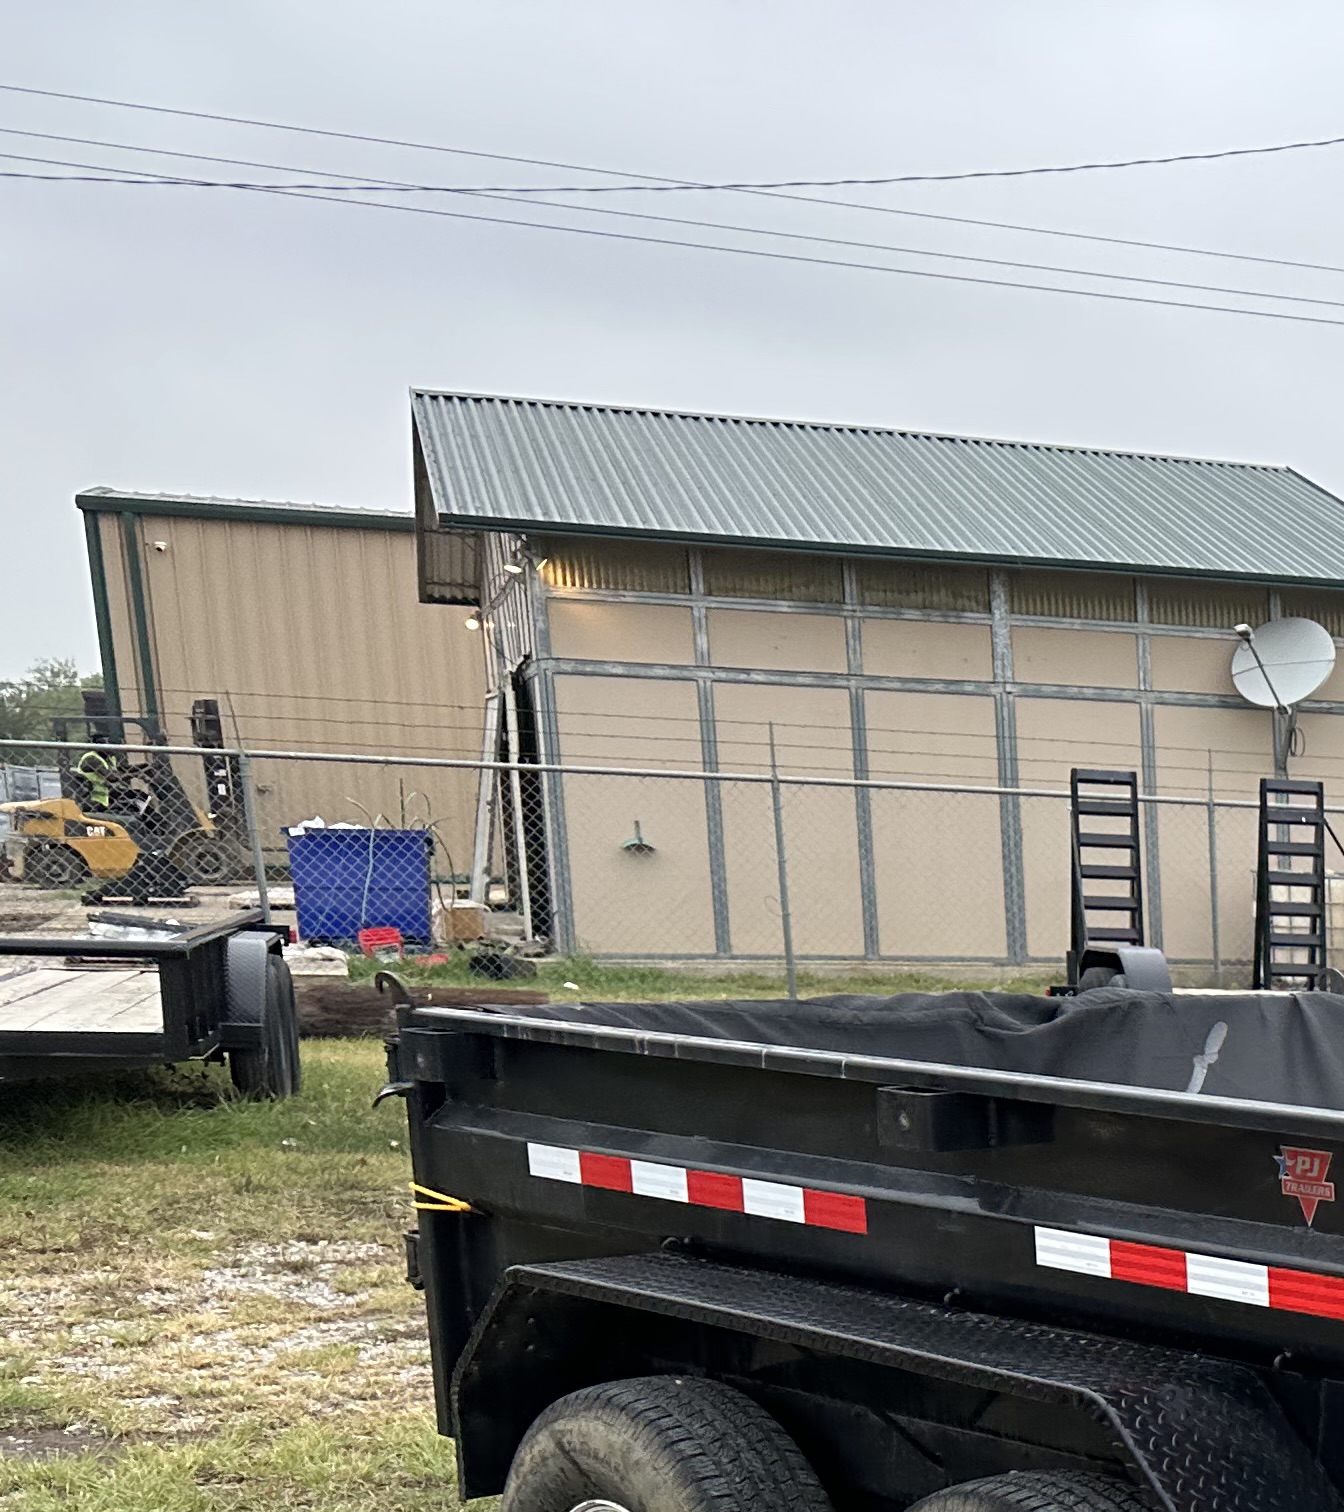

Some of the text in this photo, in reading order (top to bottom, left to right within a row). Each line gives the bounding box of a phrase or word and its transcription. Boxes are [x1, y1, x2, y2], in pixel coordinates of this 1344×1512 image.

[86, 825, 106, 837] CAT
[1295, 1155, 1320, 1177] PJ
[1285, 1181, 1331, 1197] TRAILERS
